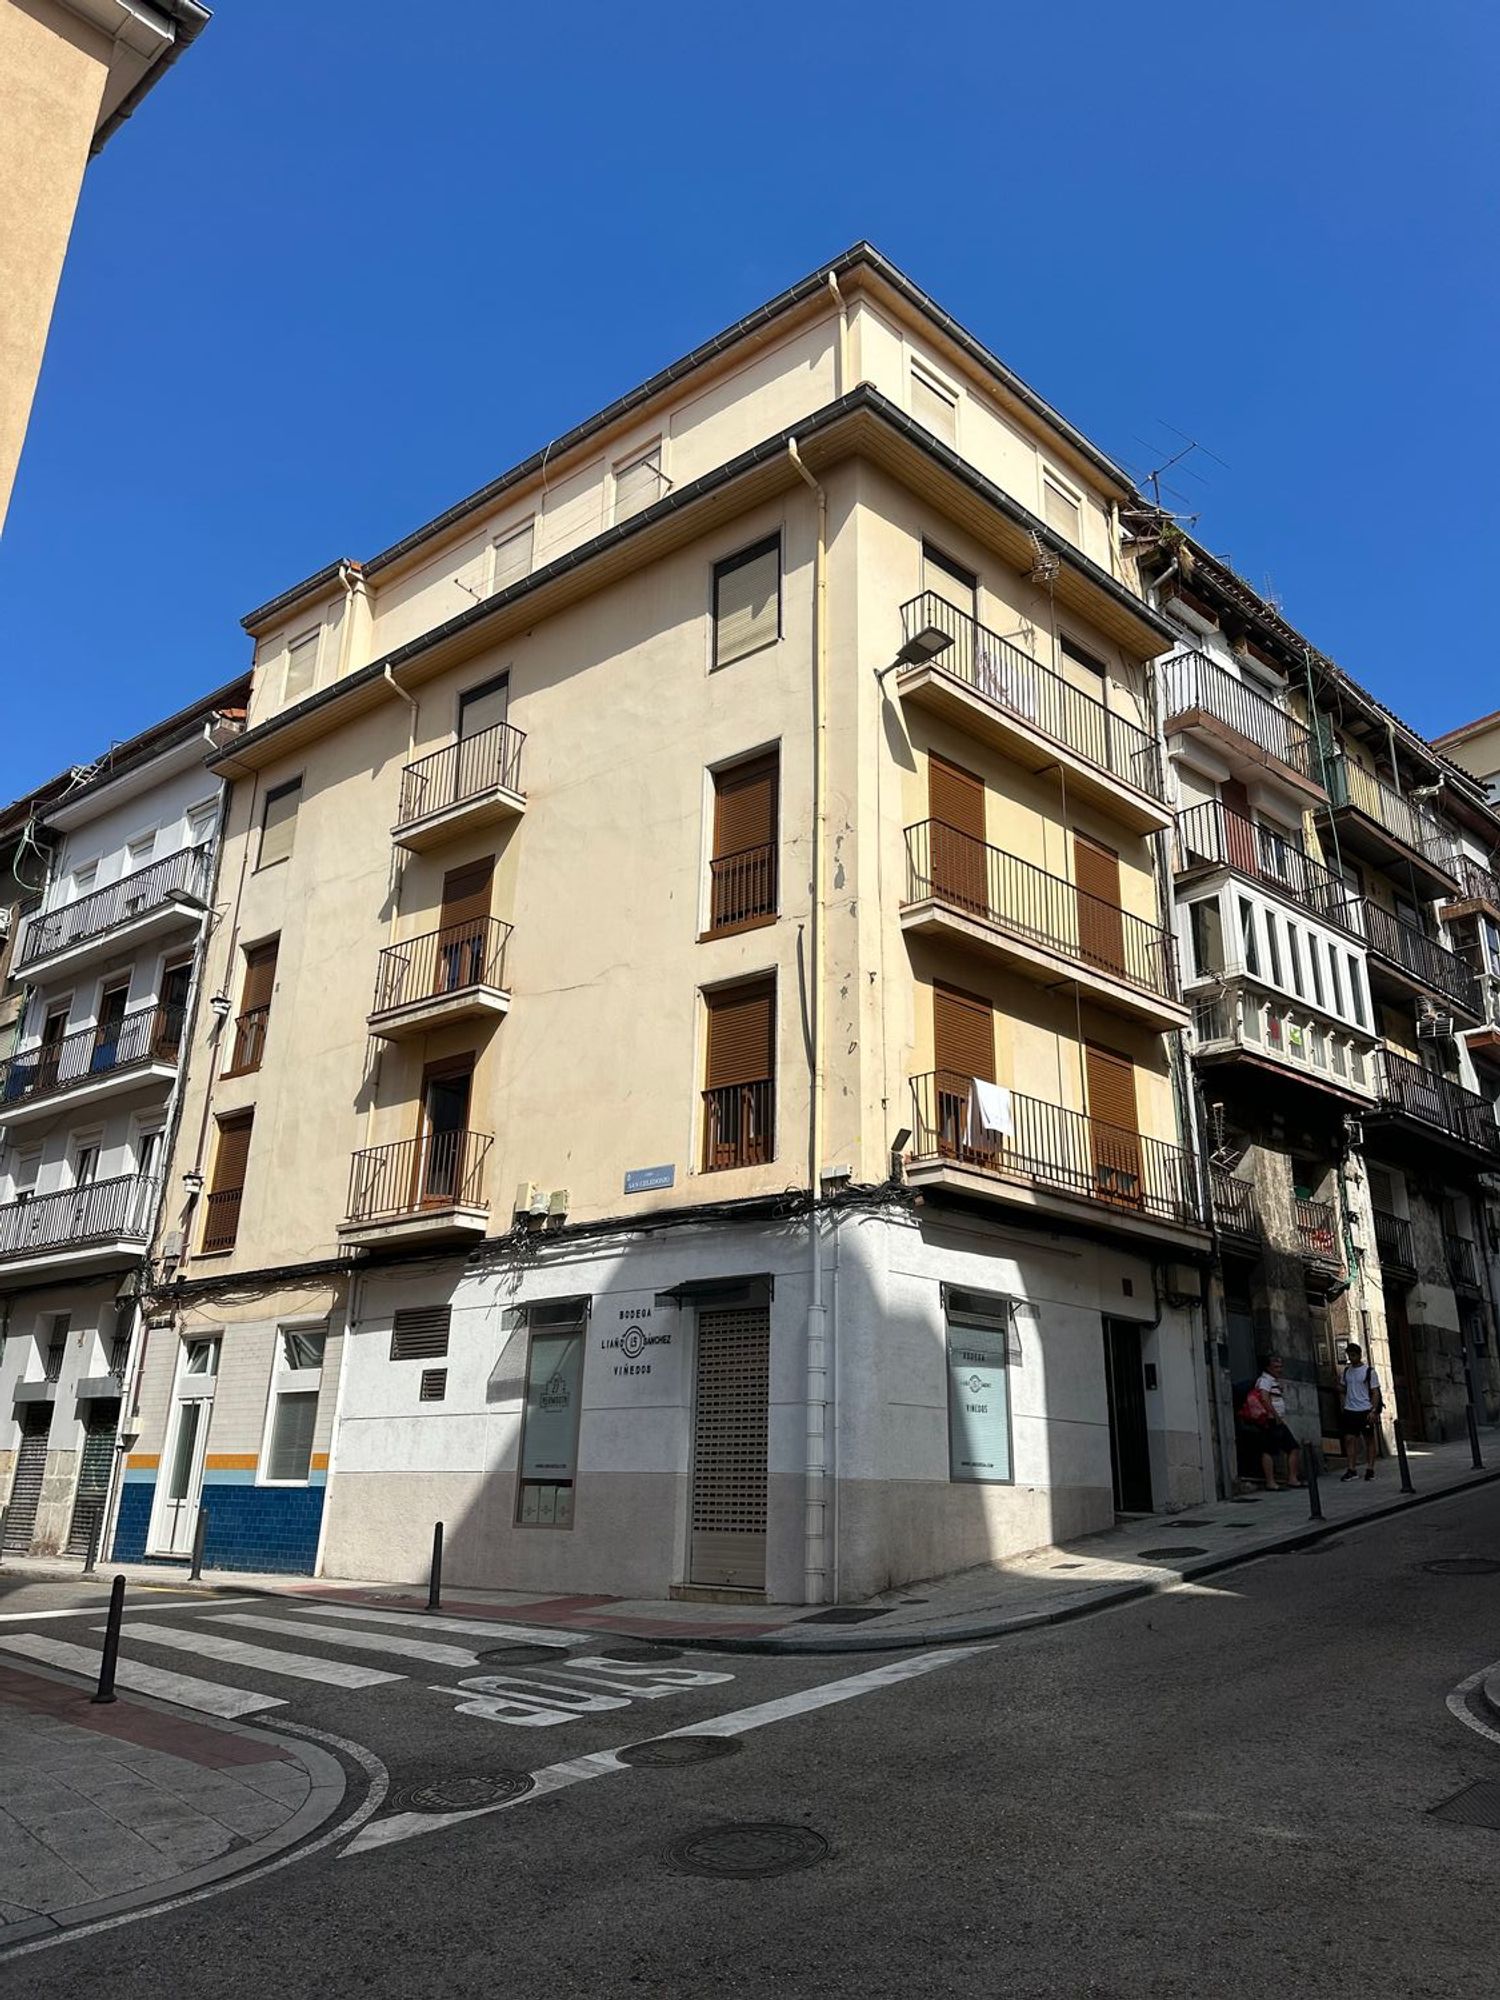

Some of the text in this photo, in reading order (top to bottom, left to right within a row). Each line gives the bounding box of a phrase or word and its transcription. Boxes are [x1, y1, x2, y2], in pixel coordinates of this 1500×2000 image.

[619, 1308, 652, 1320] BODEGA
[614, 1363, 652, 1375] VIÑEDOS
[427, 1656, 736, 1727] STOP
